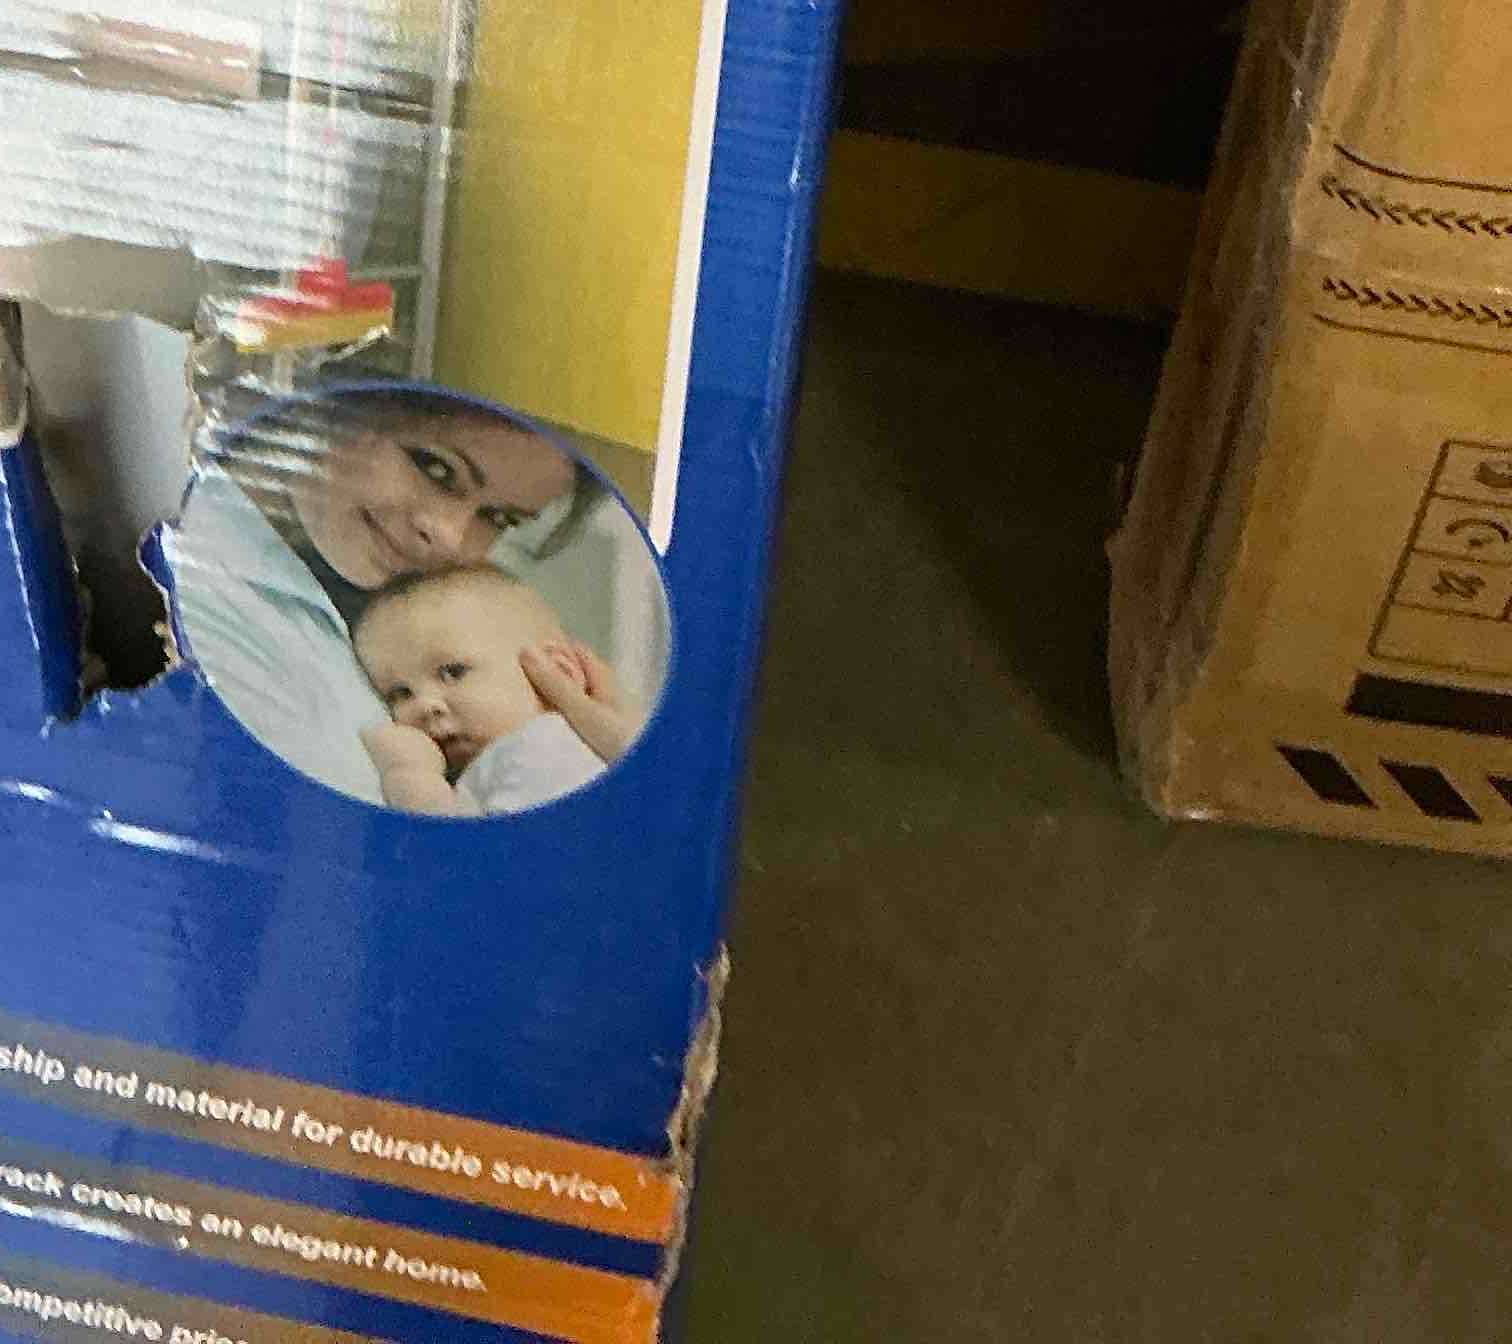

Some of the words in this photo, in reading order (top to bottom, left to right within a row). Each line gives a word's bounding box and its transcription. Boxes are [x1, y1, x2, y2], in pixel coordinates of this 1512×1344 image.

[73, 1064, 139, 1099] and
[145, 1081, 285, 1132] material
[292, 1110, 344, 1147] for
[350, 1126, 483, 1178] durable
[71, 1181, 193, 1228] creates
[200, 1212, 243, 1240] an
[249, 1222, 379, 1271] elegant
